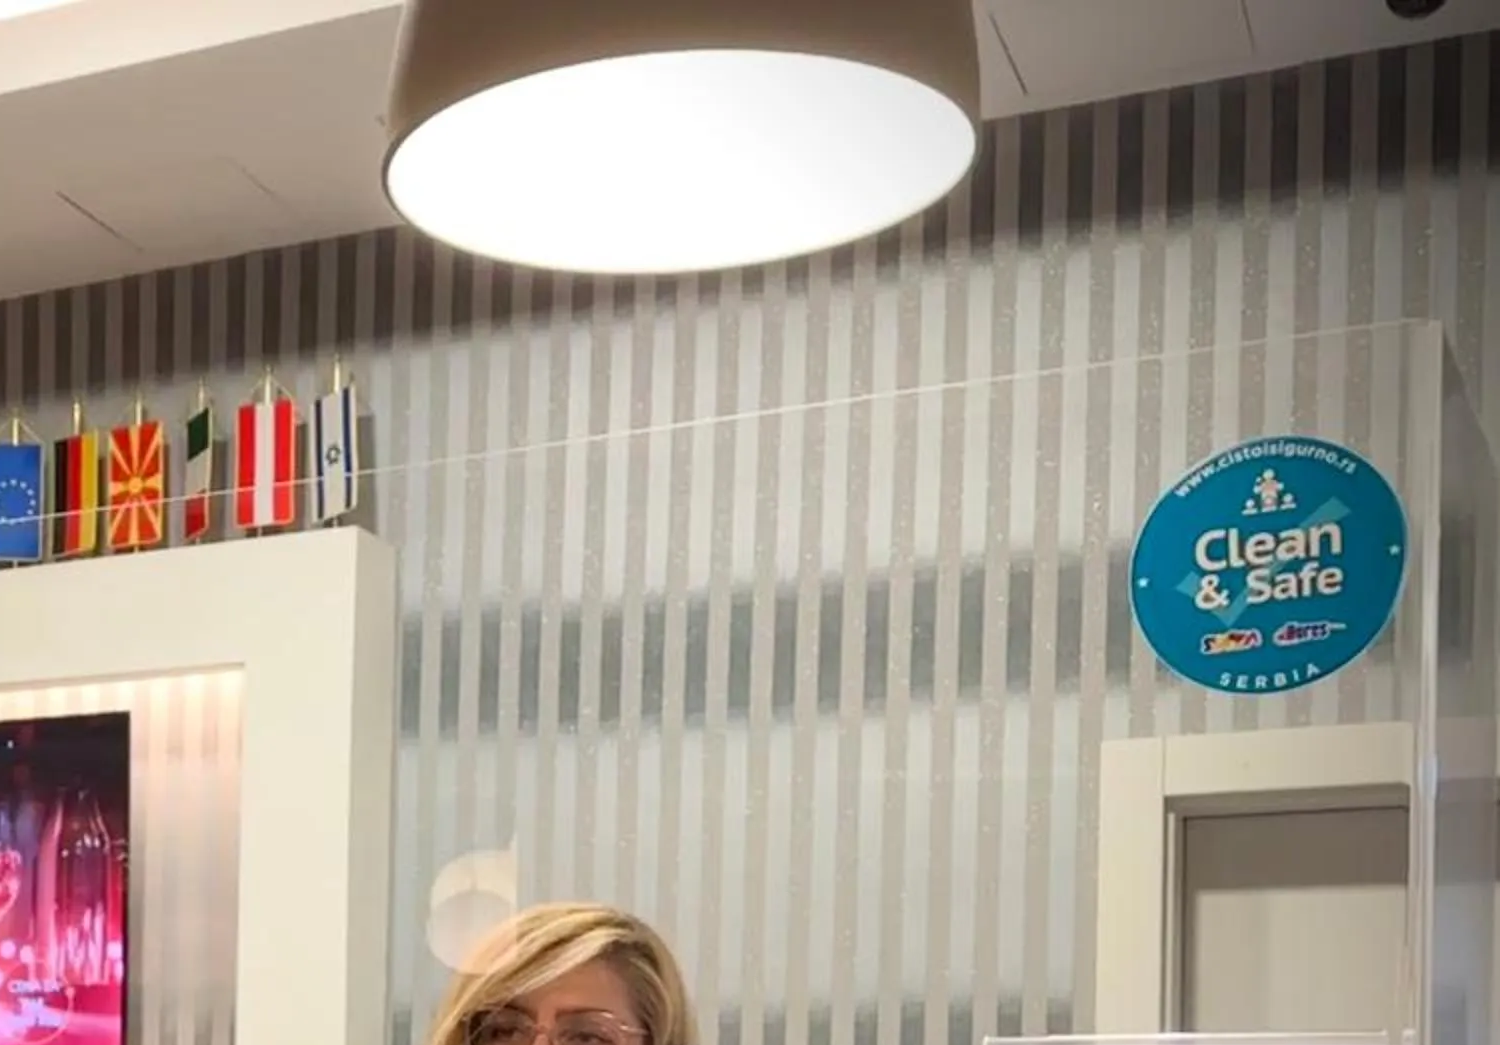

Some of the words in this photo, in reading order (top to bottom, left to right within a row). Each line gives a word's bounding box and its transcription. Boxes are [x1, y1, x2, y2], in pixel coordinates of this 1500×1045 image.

[1174, 439, 1357, 498] www.cistoisigurno.rs
[1194, 521, 1343, 572] Clean
[1194, 573, 1230, 610] &
[1246, 561, 1344, 605] Safe
[1219, 662, 1321, 690] SERBIA
